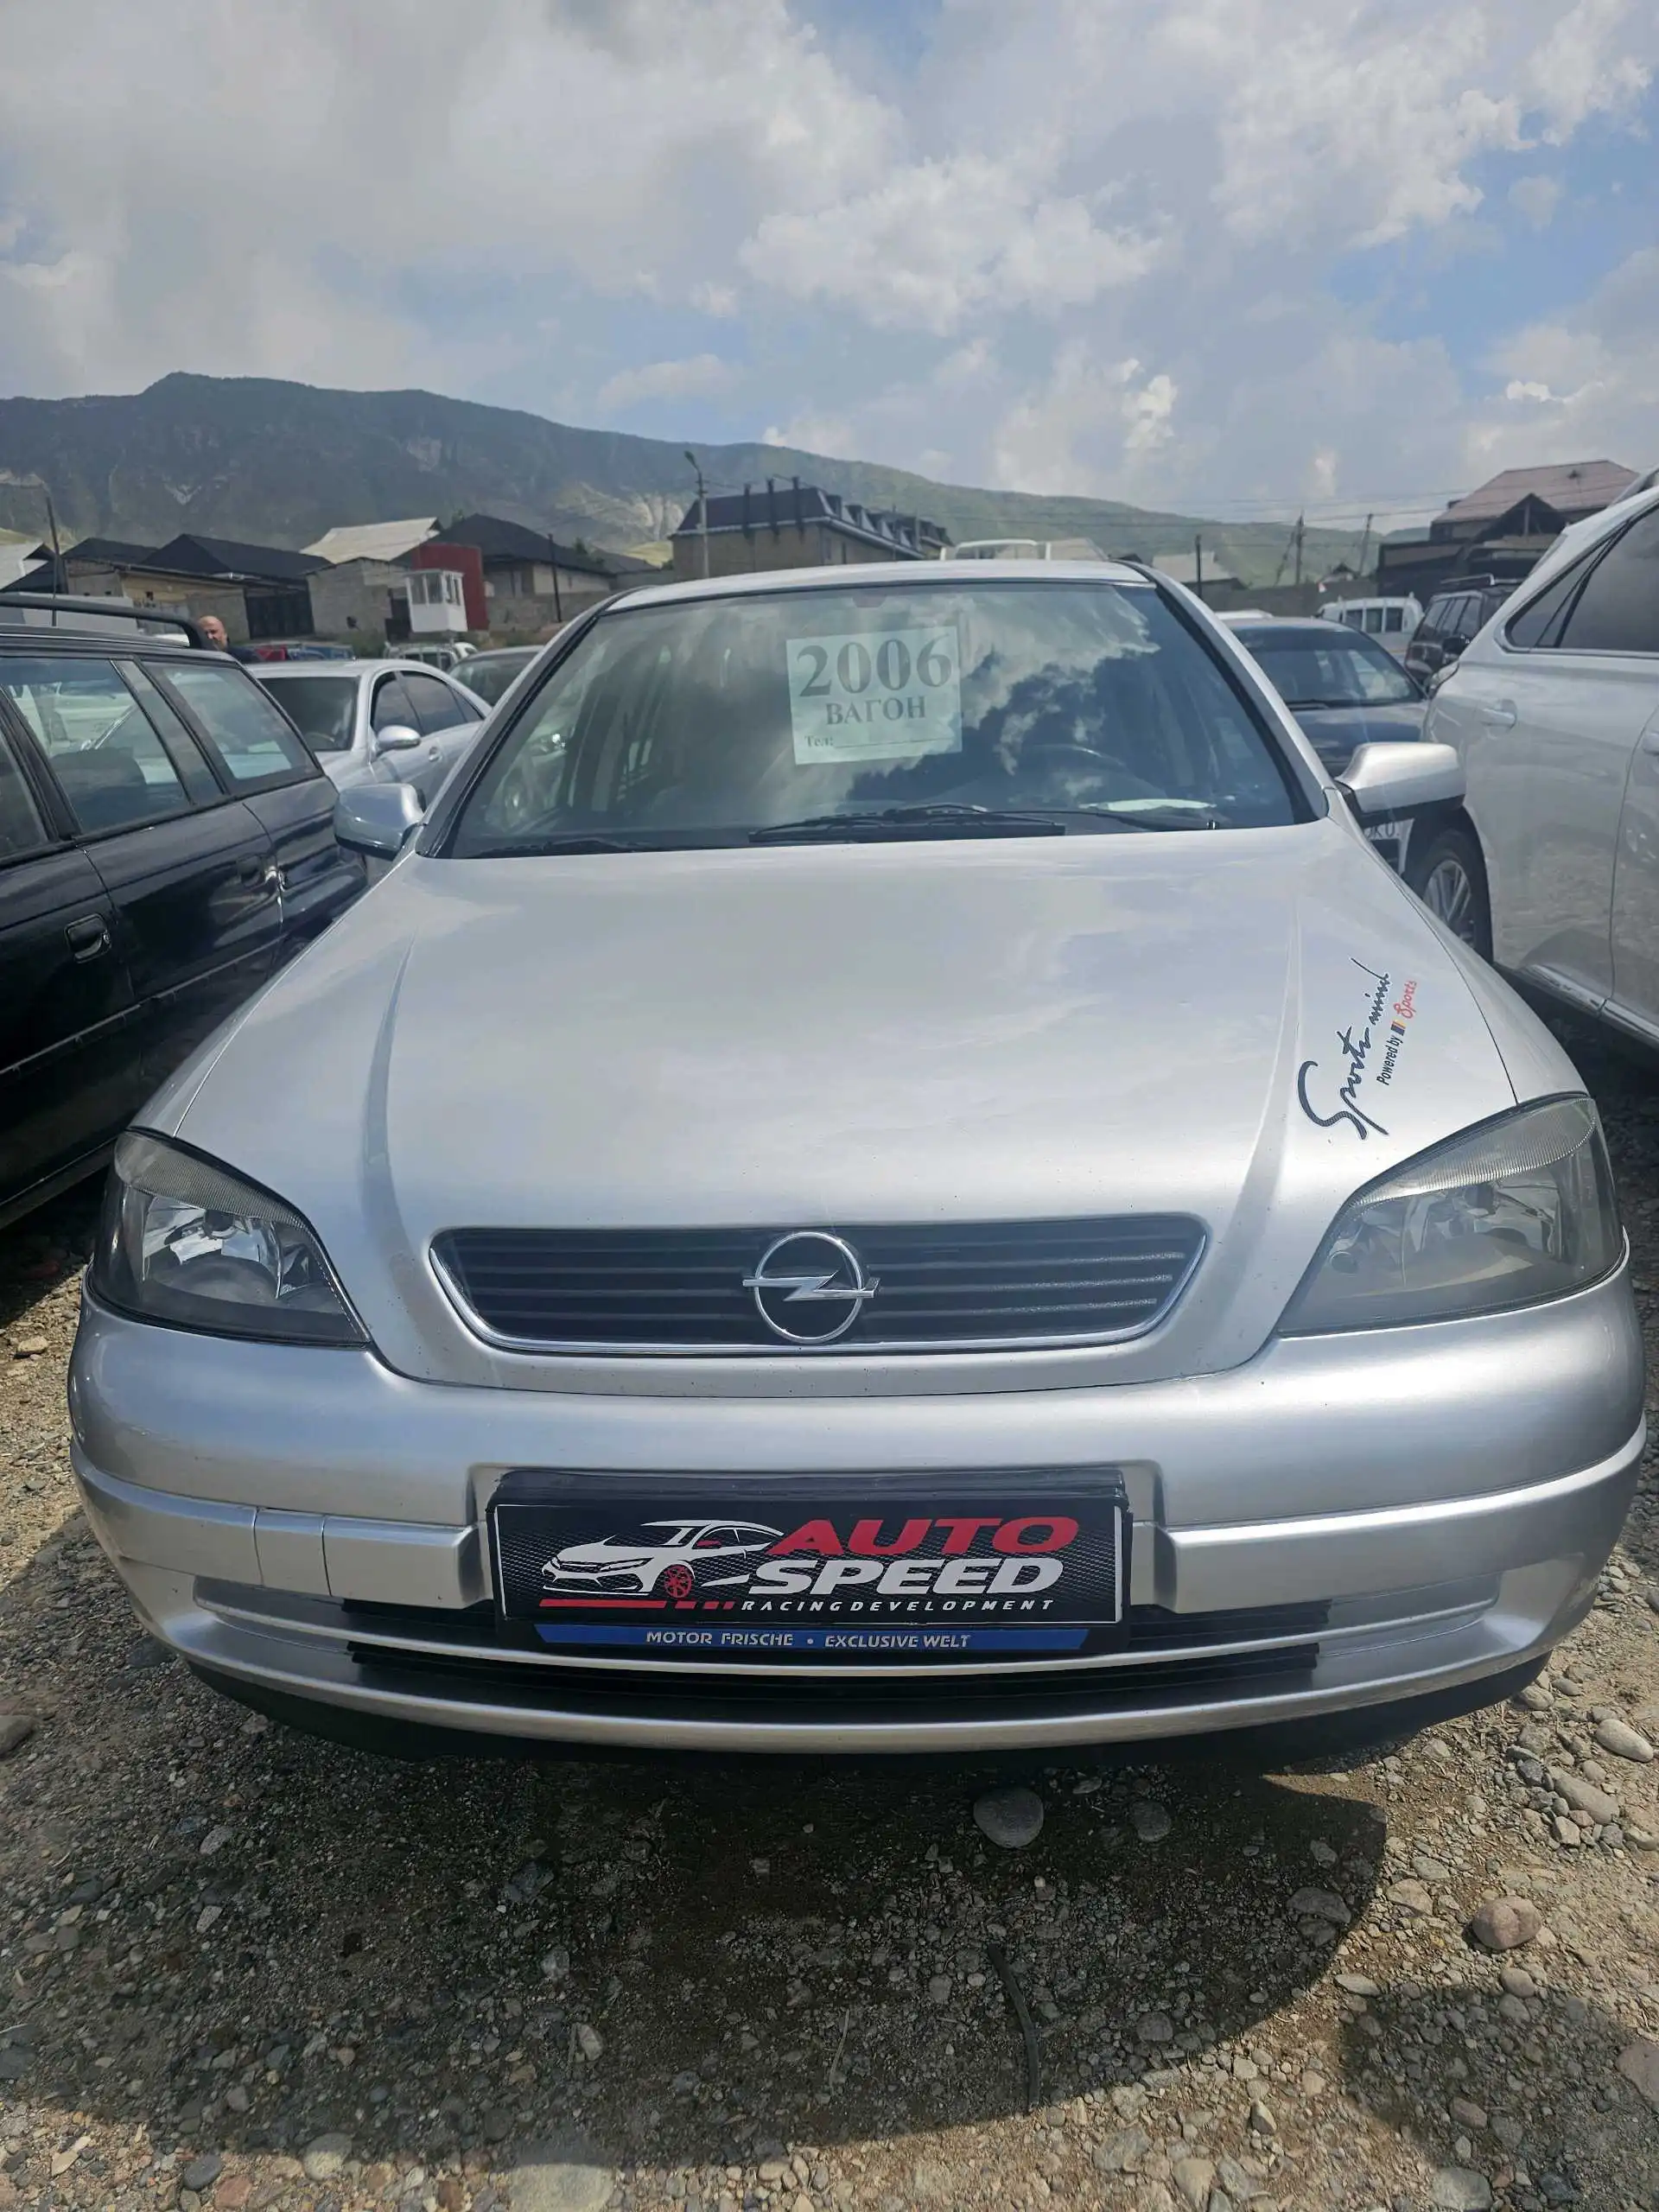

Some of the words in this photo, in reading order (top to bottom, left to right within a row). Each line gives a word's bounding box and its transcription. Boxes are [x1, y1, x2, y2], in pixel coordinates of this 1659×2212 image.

[797, 633, 951, 697] 2006
[825, 696, 926, 725] ВАГОН
[1393, 980, 1417, 1019] Sports
[1386, 1035, 1403, 1046] by
[1376, 1045, 1398, 1085] Powered
[767, 1516, 1079, 1555] AUTO
[749, 1558, 1064, 1595] SPEED
[646, 1631, 713, 1645] MOTOR
[721, 1633, 793, 1646] FRISCHE
[824, 1635, 918, 1648] EXCLUSIVE
[923, 1634, 970, 1648] WELT
